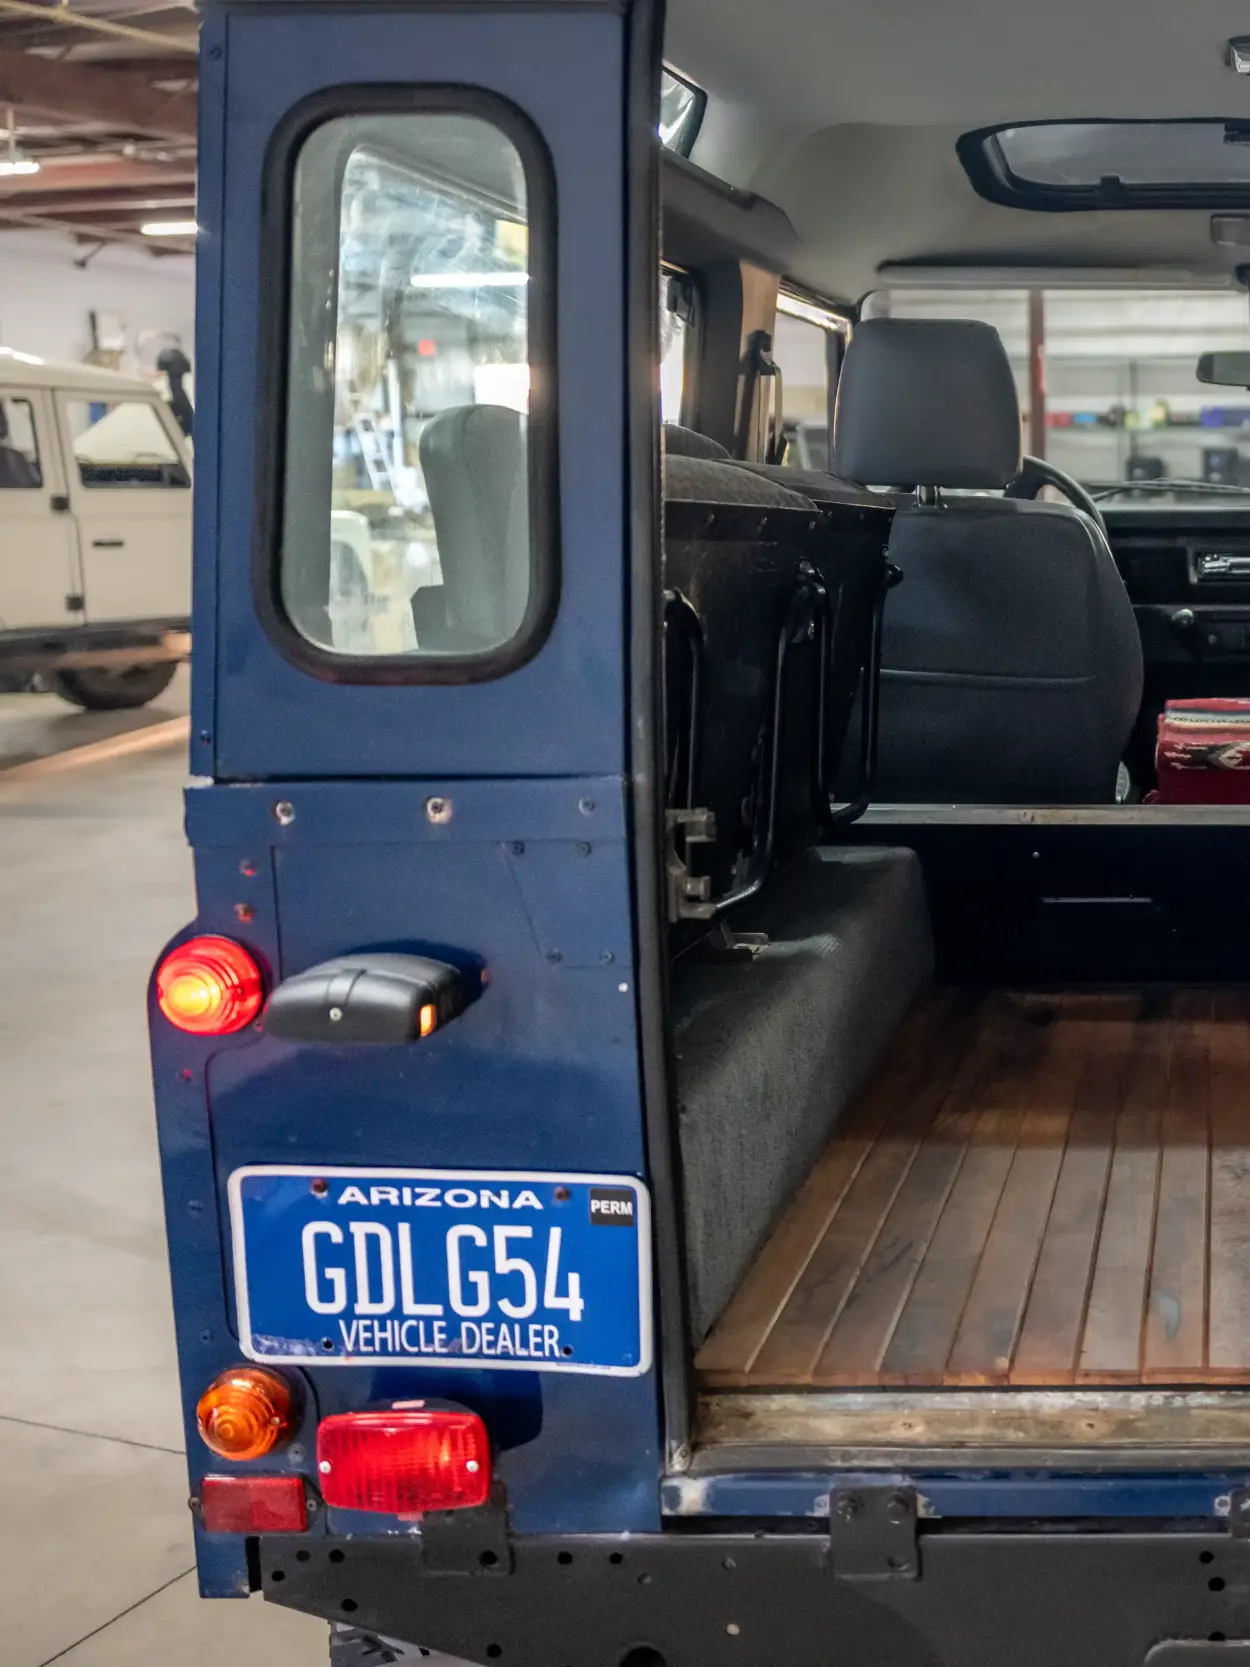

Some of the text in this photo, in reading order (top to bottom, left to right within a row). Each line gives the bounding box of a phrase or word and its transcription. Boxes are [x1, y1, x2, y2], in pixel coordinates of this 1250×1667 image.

[337, 1185, 544, 1210] ARIZONA
[591, 1199, 633, 1216] PERM
[338, 1318, 560, 1358] VEHICLE DEALER
